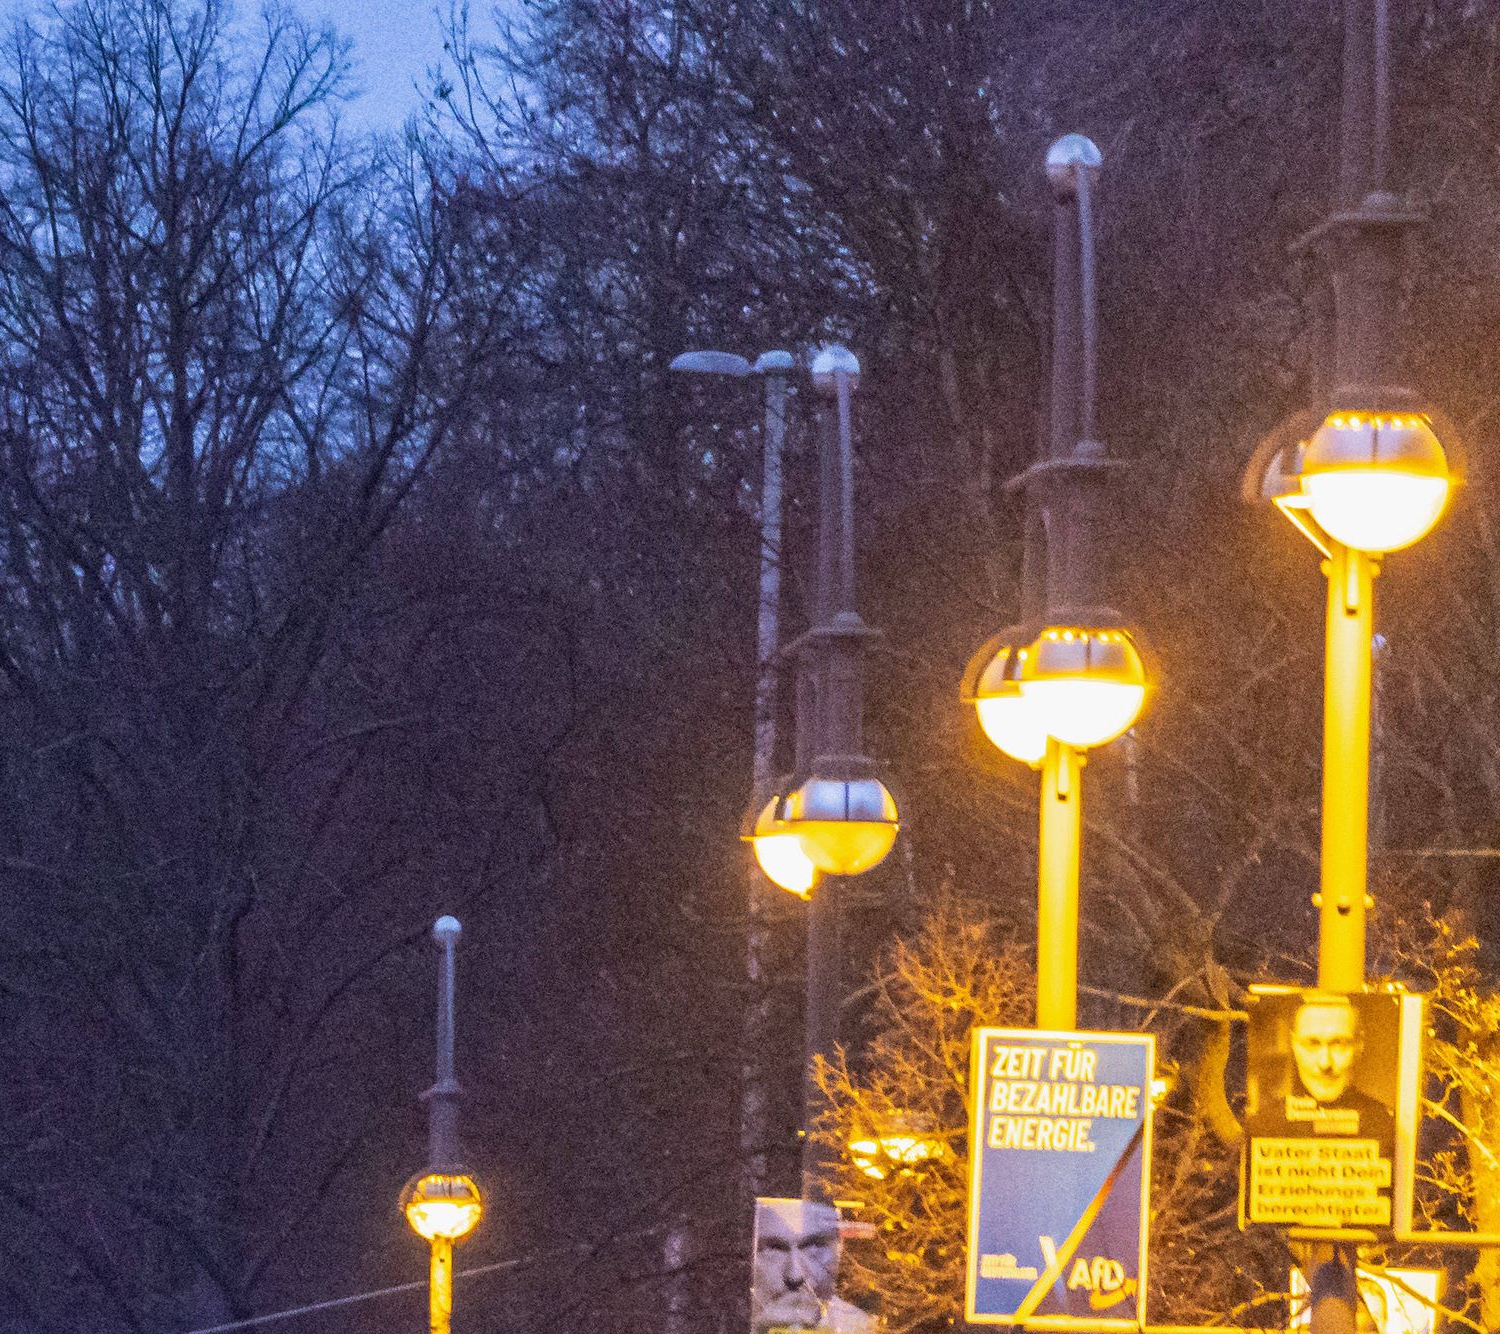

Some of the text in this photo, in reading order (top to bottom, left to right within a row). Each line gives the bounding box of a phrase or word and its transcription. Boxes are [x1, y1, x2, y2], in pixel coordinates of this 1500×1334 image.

[991, 1042, 1097, 1081] ZEIT FÜR
[988, 1080, 1141, 1118] BEZAHLBARE
[987, 1116, 1097, 1153] ENERGIE.
[1259, 1147, 1373, 1159] Vater Staat
[1257, 1165, 1283, 1178] ist
[1288, 1165, 1336, 1178] nicht
[1068, 1257, 1125, 1291] AfD
